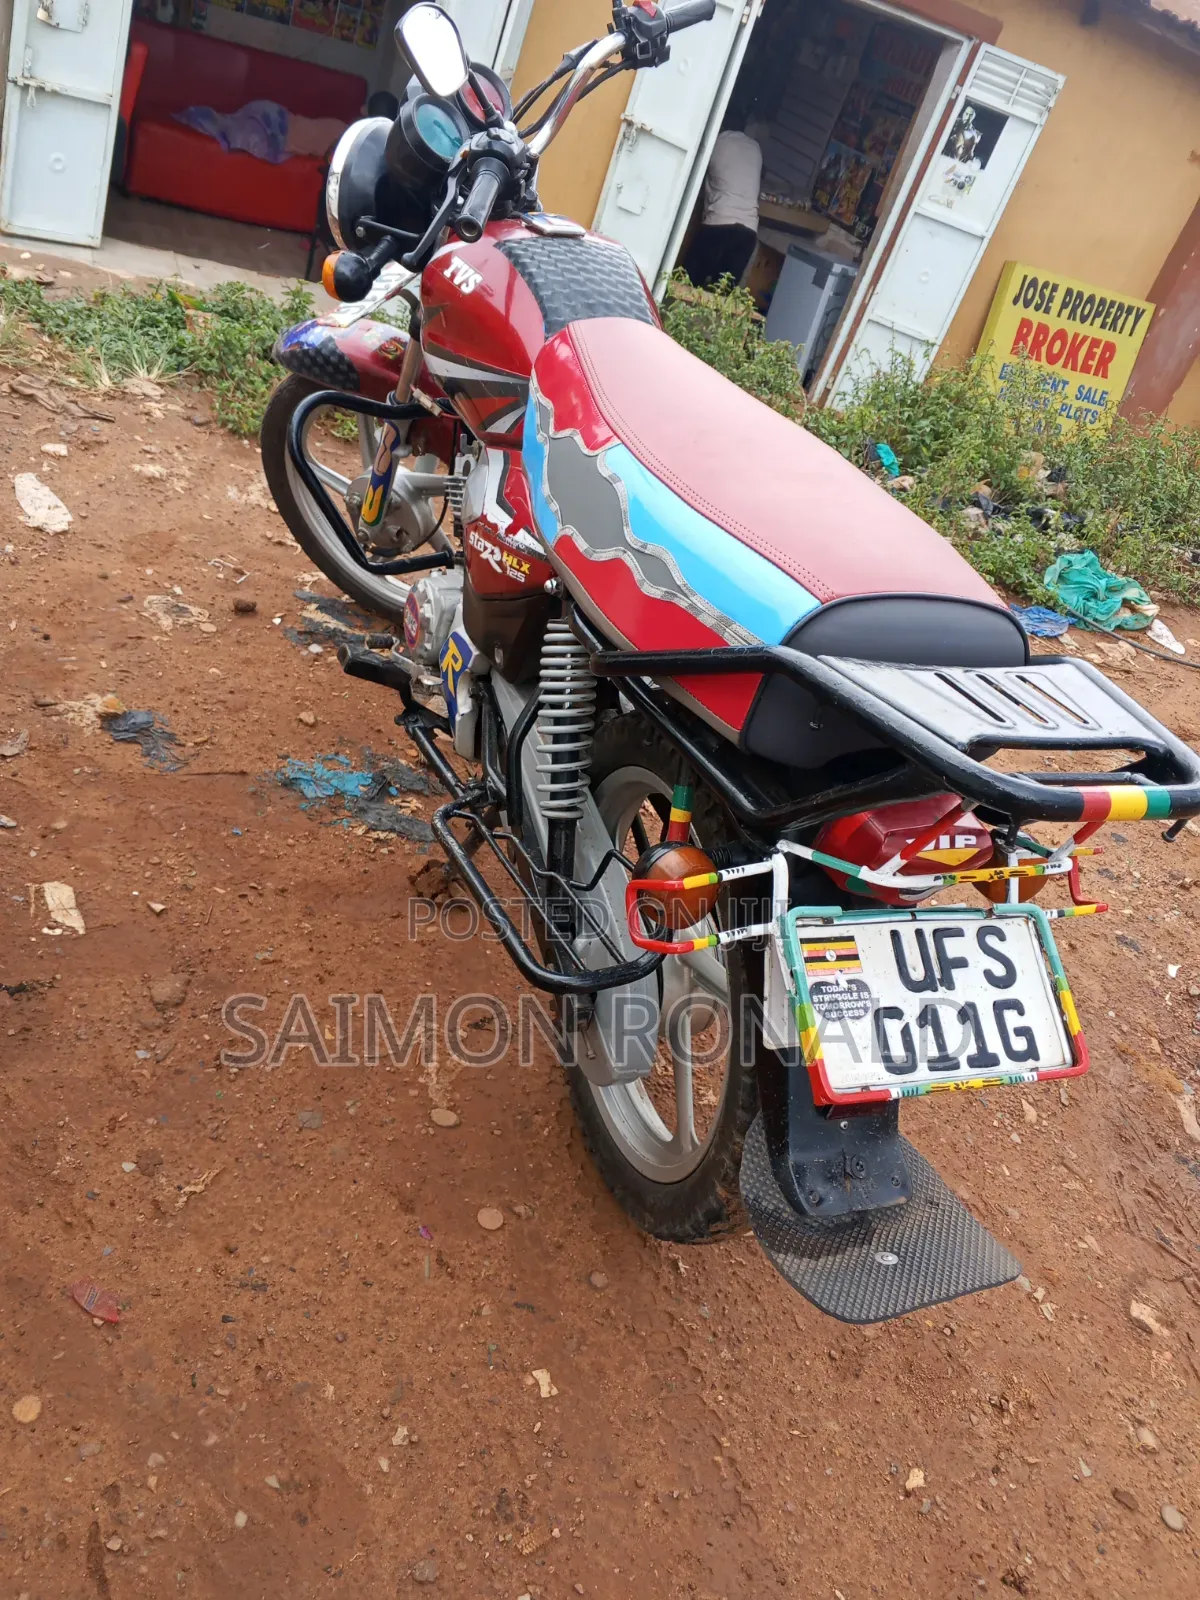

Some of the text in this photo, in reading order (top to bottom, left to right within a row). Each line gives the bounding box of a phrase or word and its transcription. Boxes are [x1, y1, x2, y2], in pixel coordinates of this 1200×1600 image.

[443, 256, 483, 295] TVS
[1012, 274, 1147, 337] JOSE PROPERTY
[1010, 317, 1117, 379] BROKER
[503, 550, 531, 575] HLX
[506, 564, 526, 583] 125
[890, 925, 1018, 993] UFS
[813, 991, 870, 1003] STRUGGLE IS
[814, 1000, 872, 1011] TOMORROW'S
[873, 998, 1041, 1076] 011G
